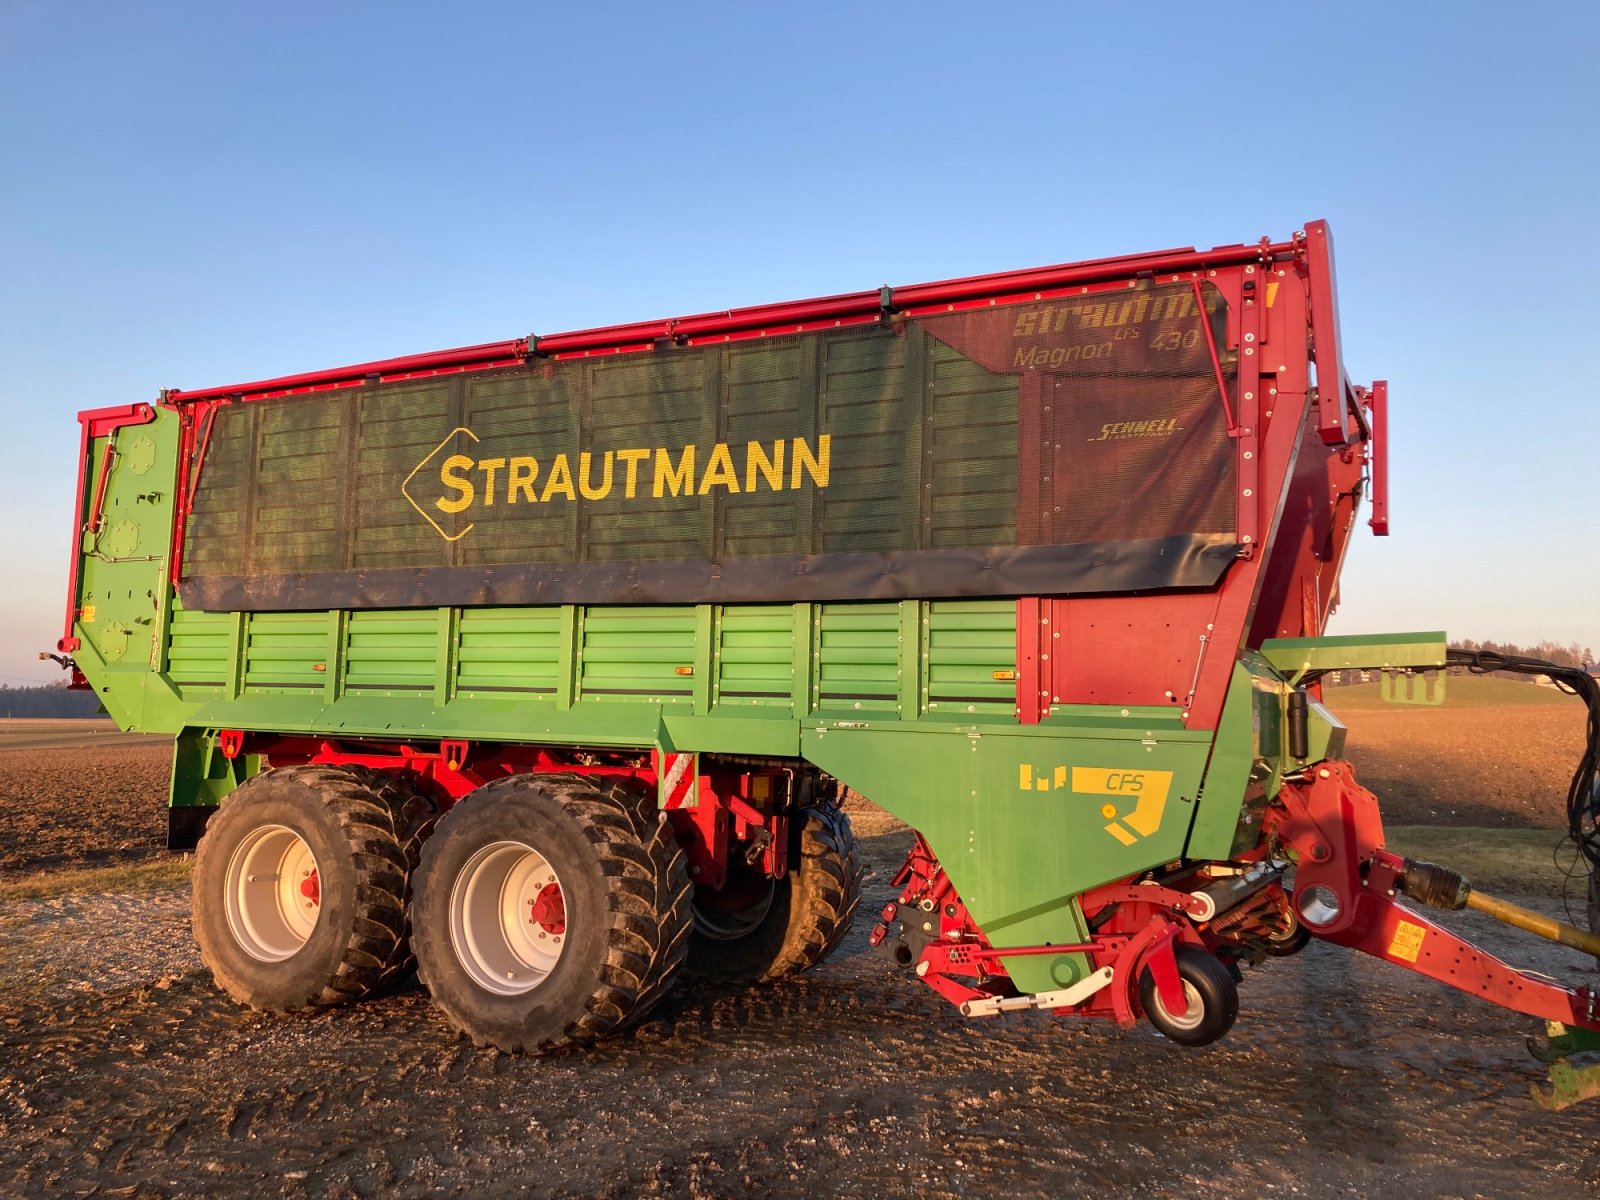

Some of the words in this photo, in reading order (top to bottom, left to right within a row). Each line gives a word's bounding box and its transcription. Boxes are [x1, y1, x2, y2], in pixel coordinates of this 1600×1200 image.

[1013, 341, 1112, 368] Magnon
[1149, 329, 1199, 351] 430
[1096, 418, 1177, 440] SCHNELL
[435, 434, 831, 513] STRAUTMANN
[1105, 773, 1145, 792] CFS
